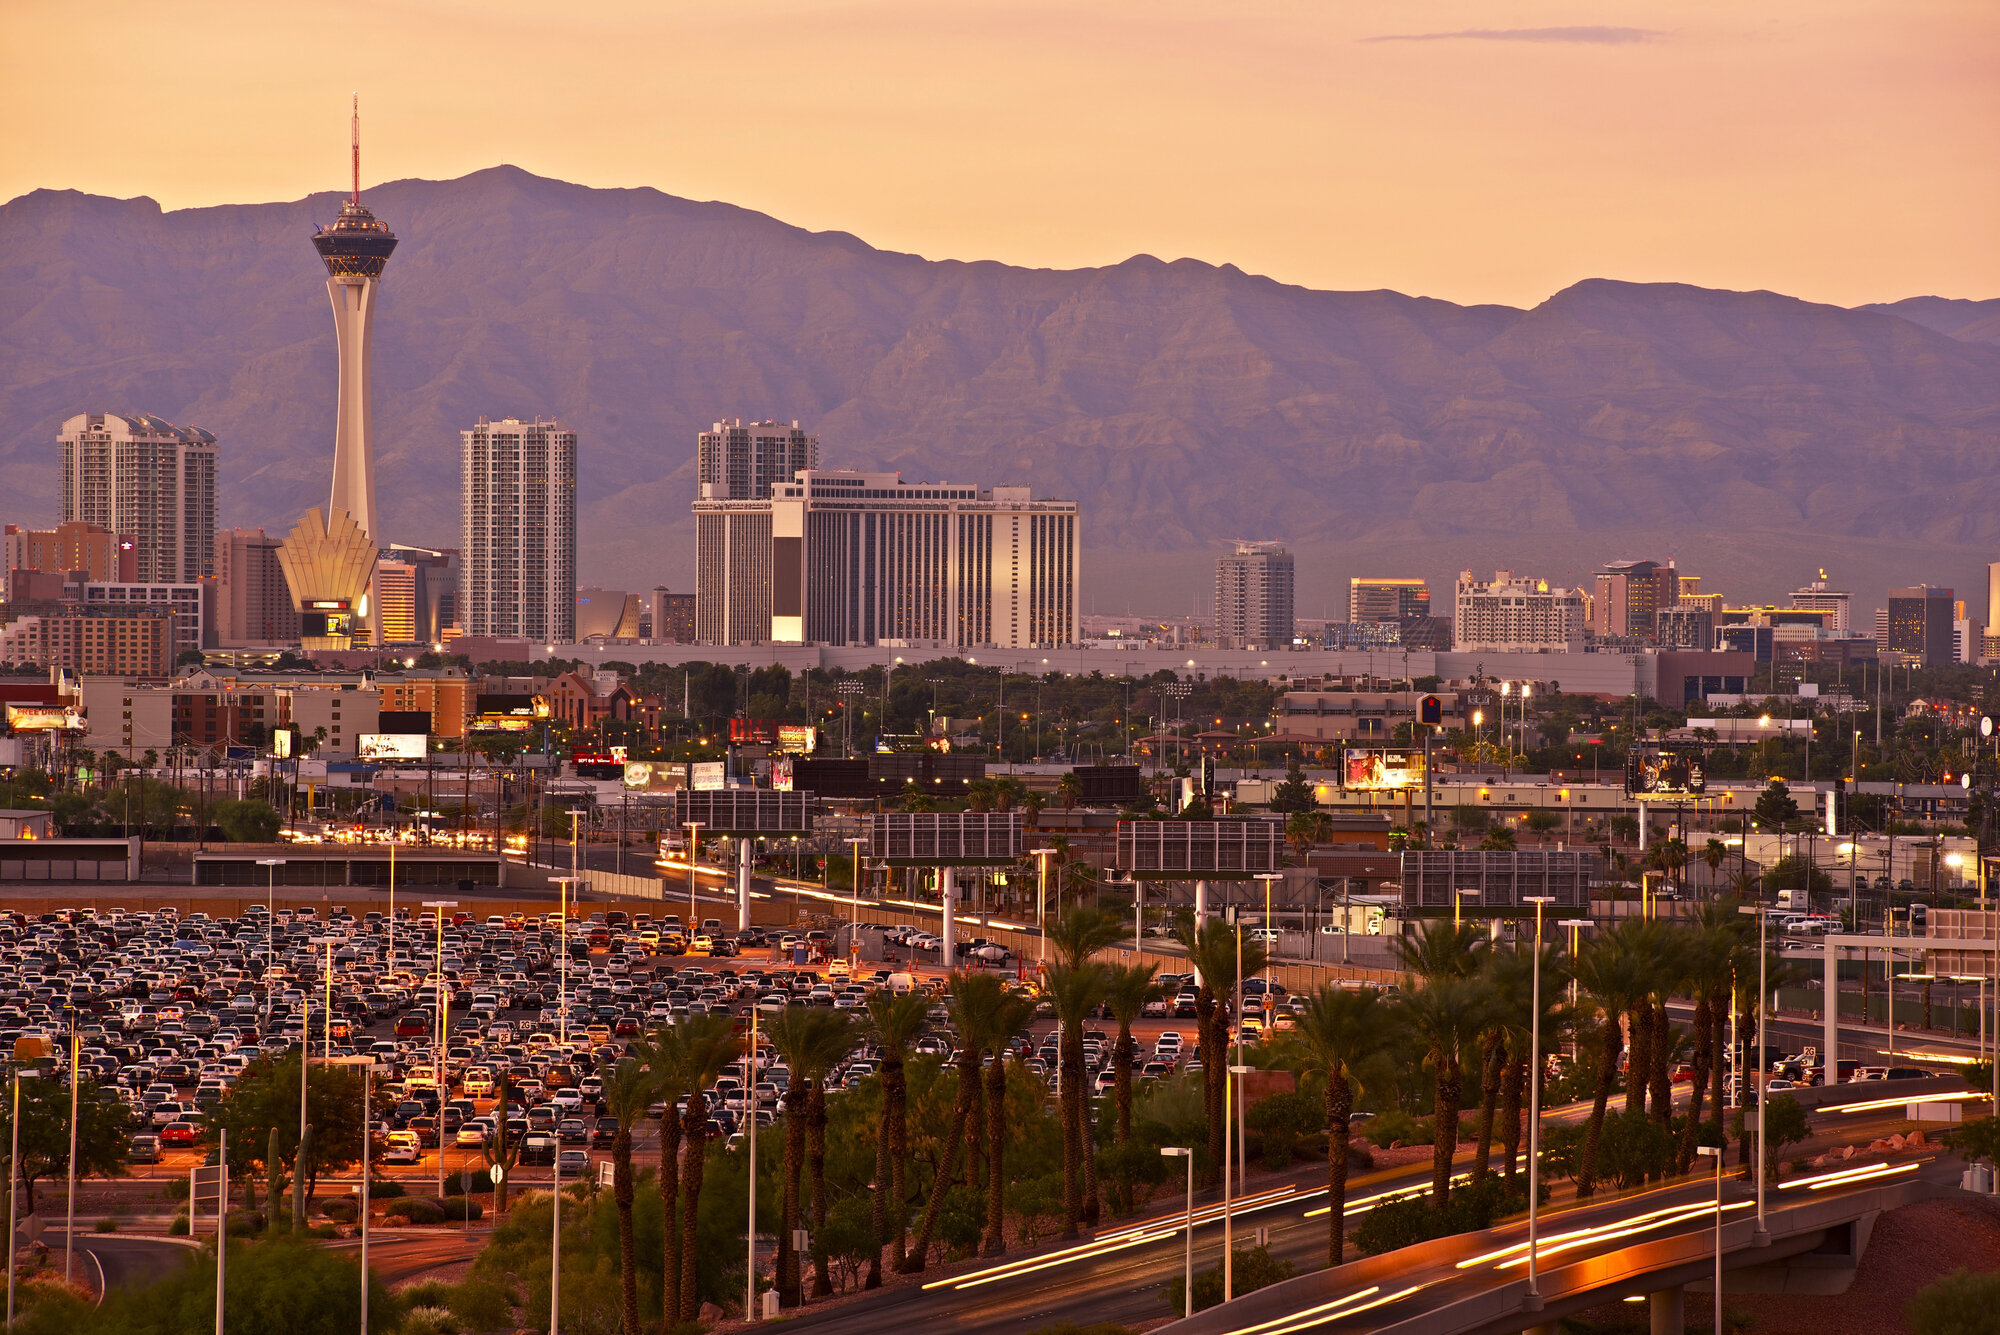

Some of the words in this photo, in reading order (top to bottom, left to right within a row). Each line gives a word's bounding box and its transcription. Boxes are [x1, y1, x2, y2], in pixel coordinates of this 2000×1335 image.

[17, 708, 40, 716] FREE
[41, 708, 75, 716] DRINKS
[500, 998, 508, 1006] 2K
[559, 1008, 567, 1016] 2J
[541, 1014, 550, 1022] 2H
[521, 1021, 530, 1029] 2G
[432, 1047, 441, 1056] 2E
[1805, 1047, 1815, 1056] 2G
[406, 1056, 416, 1064] 2D
[1856, 1070, 1864, 1078] 2F
